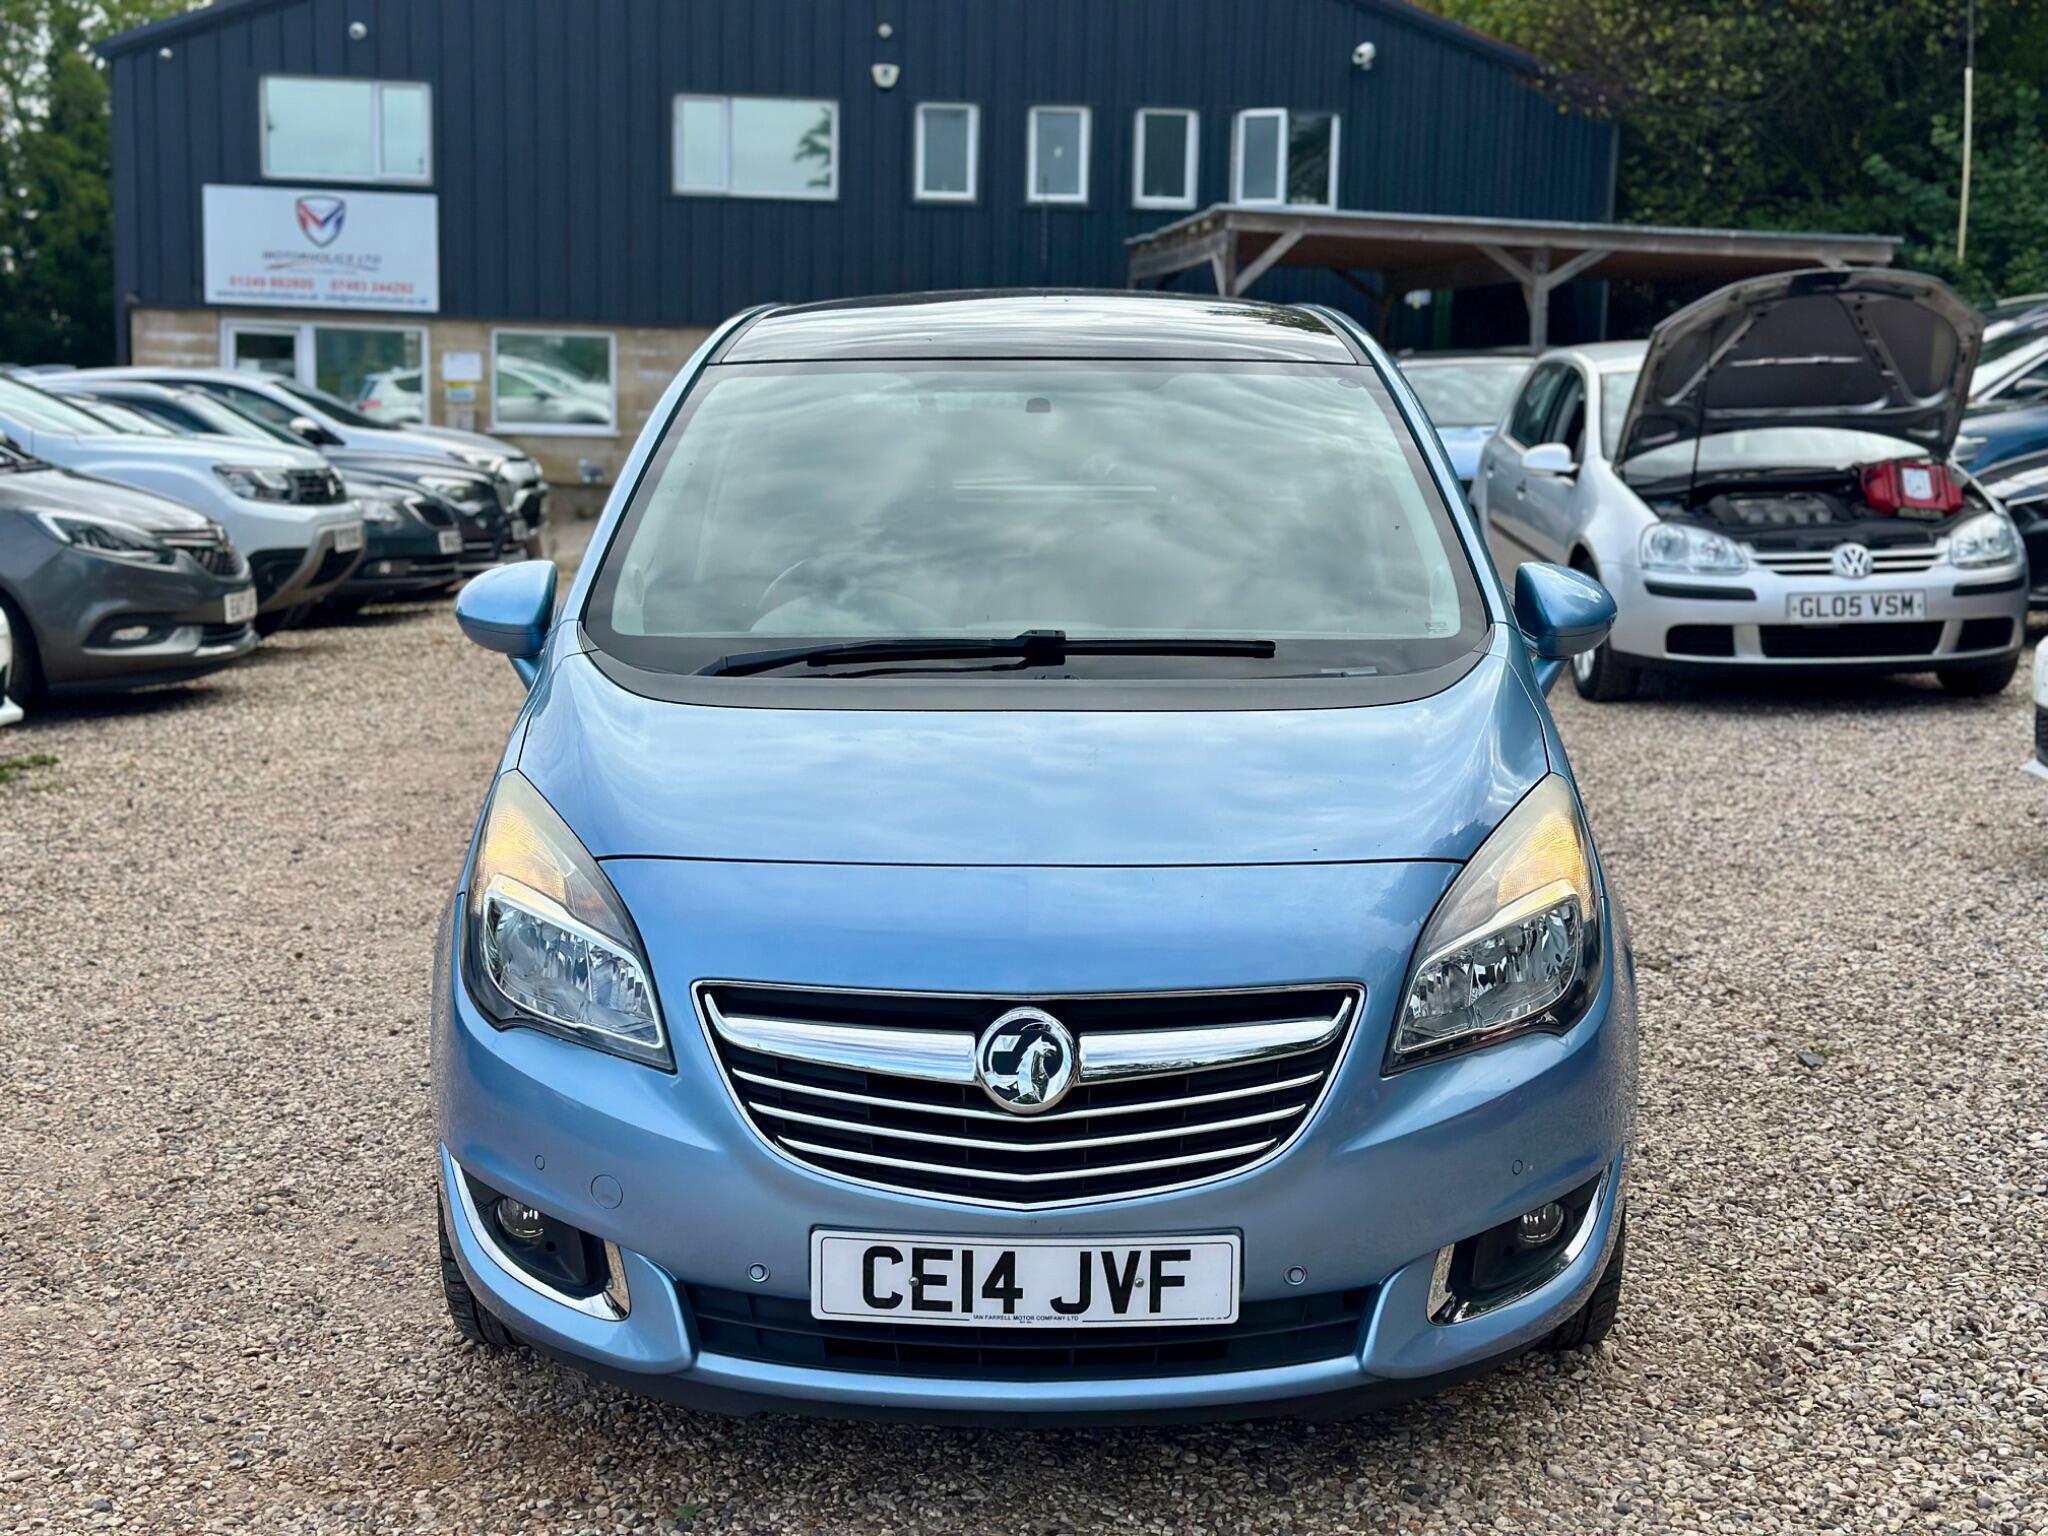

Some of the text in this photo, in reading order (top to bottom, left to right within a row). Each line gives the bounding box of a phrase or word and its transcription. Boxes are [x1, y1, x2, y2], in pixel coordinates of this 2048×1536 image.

[1800, 594, 1914, 618] GL05 VSM
[862, 1245, 1191, 1314] CE14 JVF
